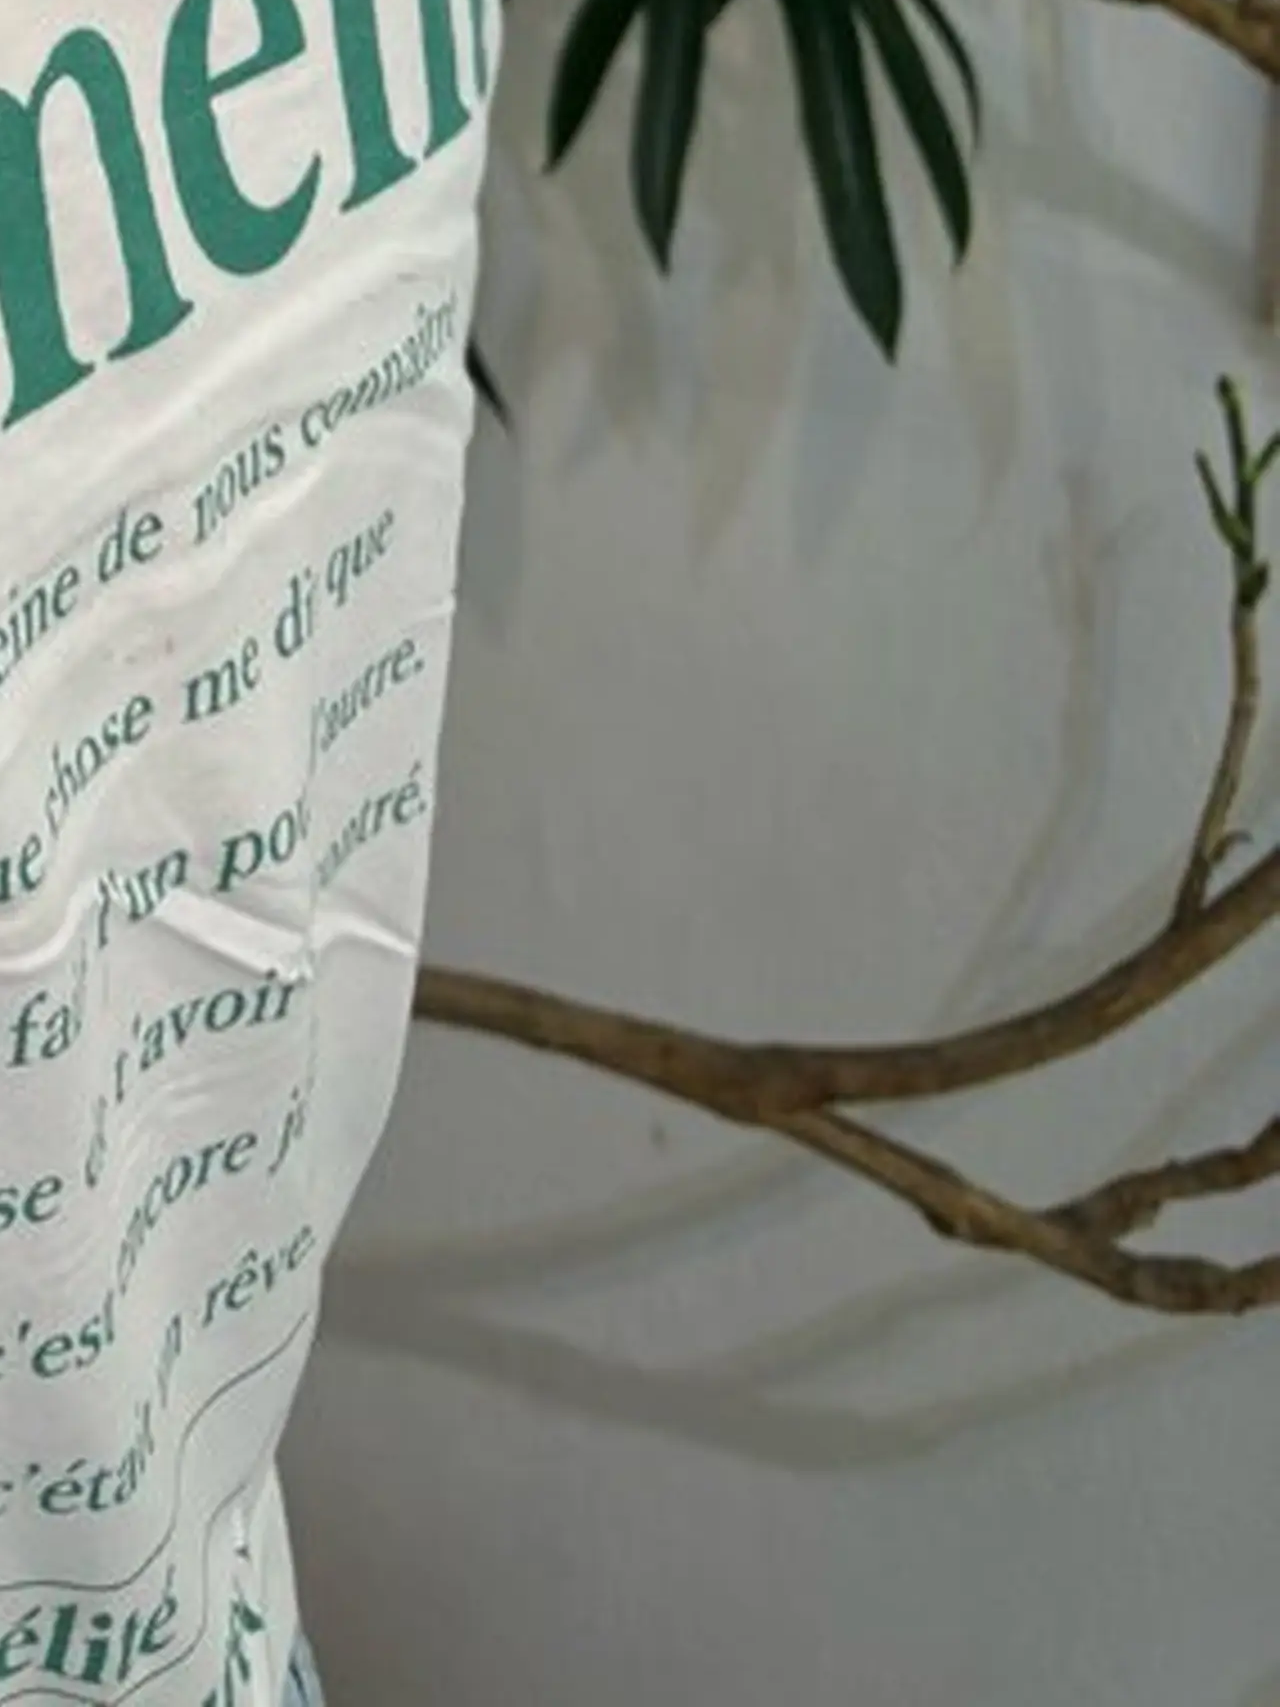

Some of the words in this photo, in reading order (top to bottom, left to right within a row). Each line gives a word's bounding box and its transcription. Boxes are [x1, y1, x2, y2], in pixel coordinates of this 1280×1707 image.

[96, 503, 165, 588] de
[190, 419, 288, 548] nous
[44, 693, 154, 841] chose
[180, 632, 262, 725] me
[325, 508, 397, 610] que
[201, 1223, 316, 1328] rêve
